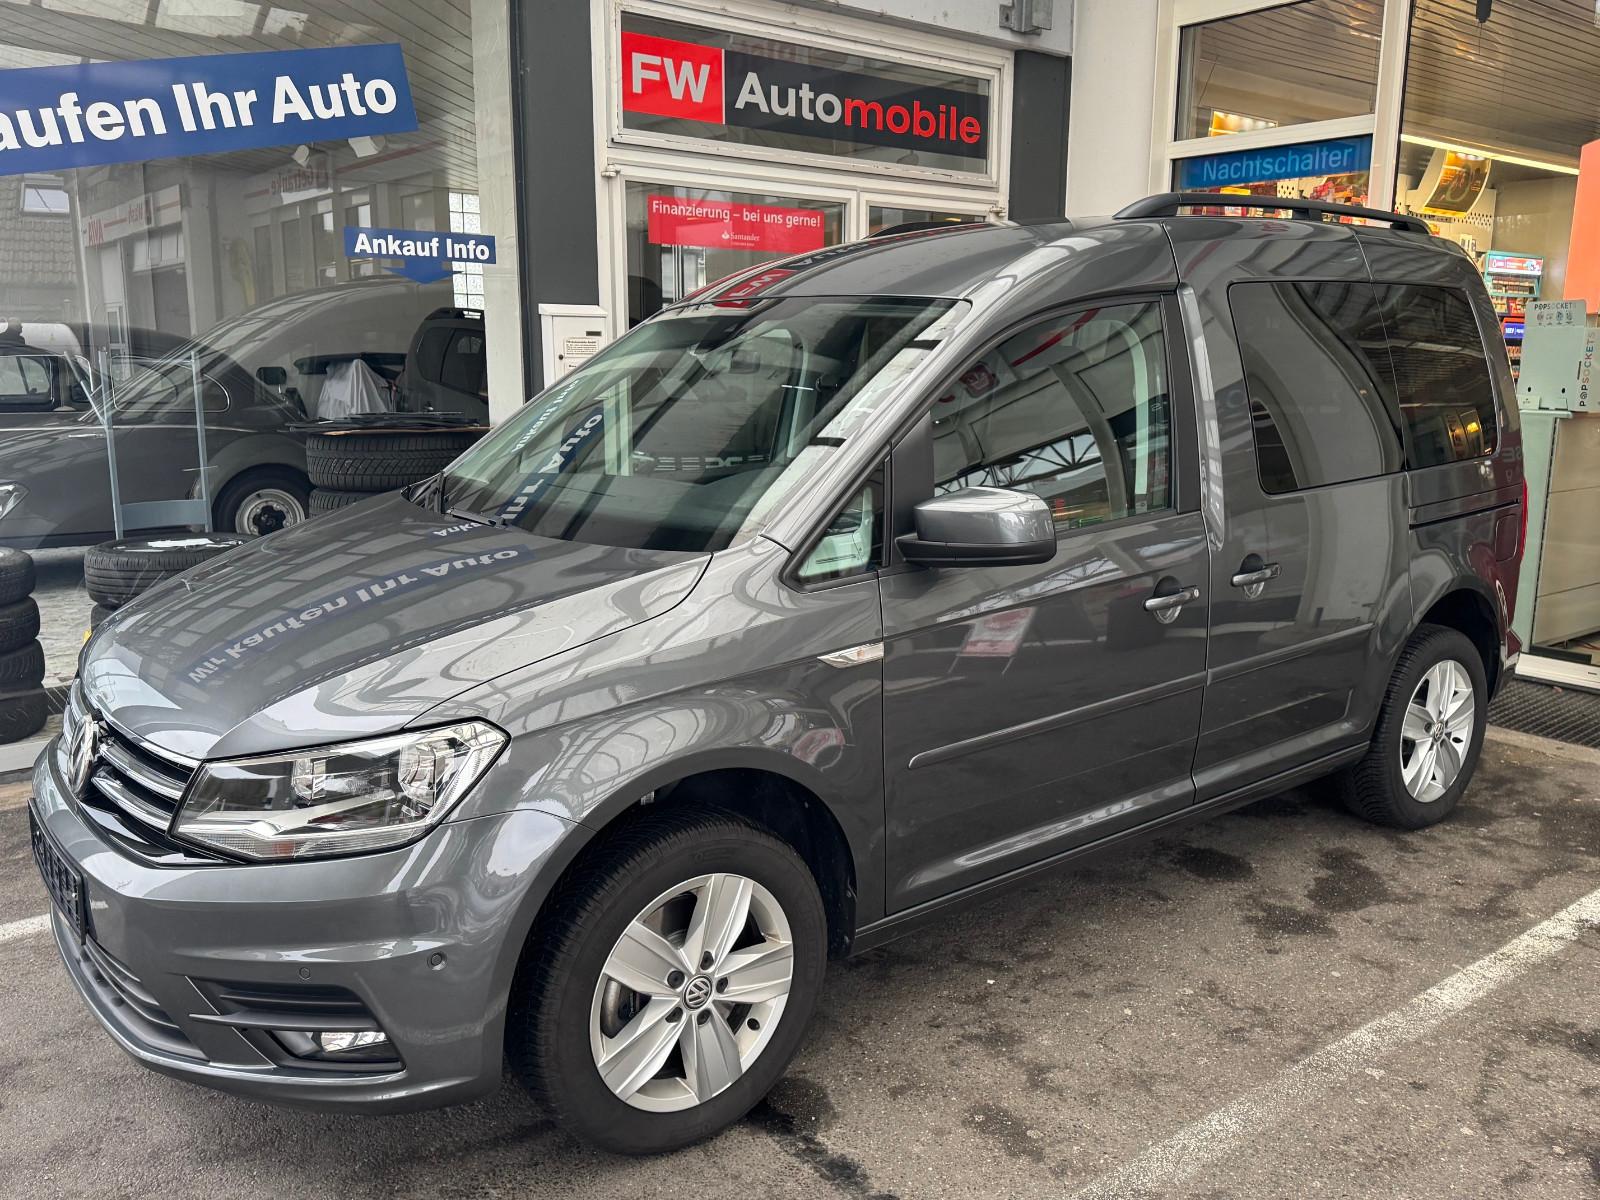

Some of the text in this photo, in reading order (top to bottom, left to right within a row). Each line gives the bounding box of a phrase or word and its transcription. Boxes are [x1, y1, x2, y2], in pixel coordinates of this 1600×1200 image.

[172, 82, 258, 132] Ihr
[272, 73, 397, 123] Auto
[631, 51, 982, 144] FW Automobile
[1202, 147, 1353, 182] Nachtschalter
[652, 200, 730, 223] Finanzierung
[743, 208, 760, 222] bei
[763, 214, 783, 224] uns
[786, 215, 821, 228] gerne!
[354, 233, 490, 260] Ankauf Info
[730, 233, 760, 243] Santander
[1579, 331, 1596, 407] POPSOCKETS
